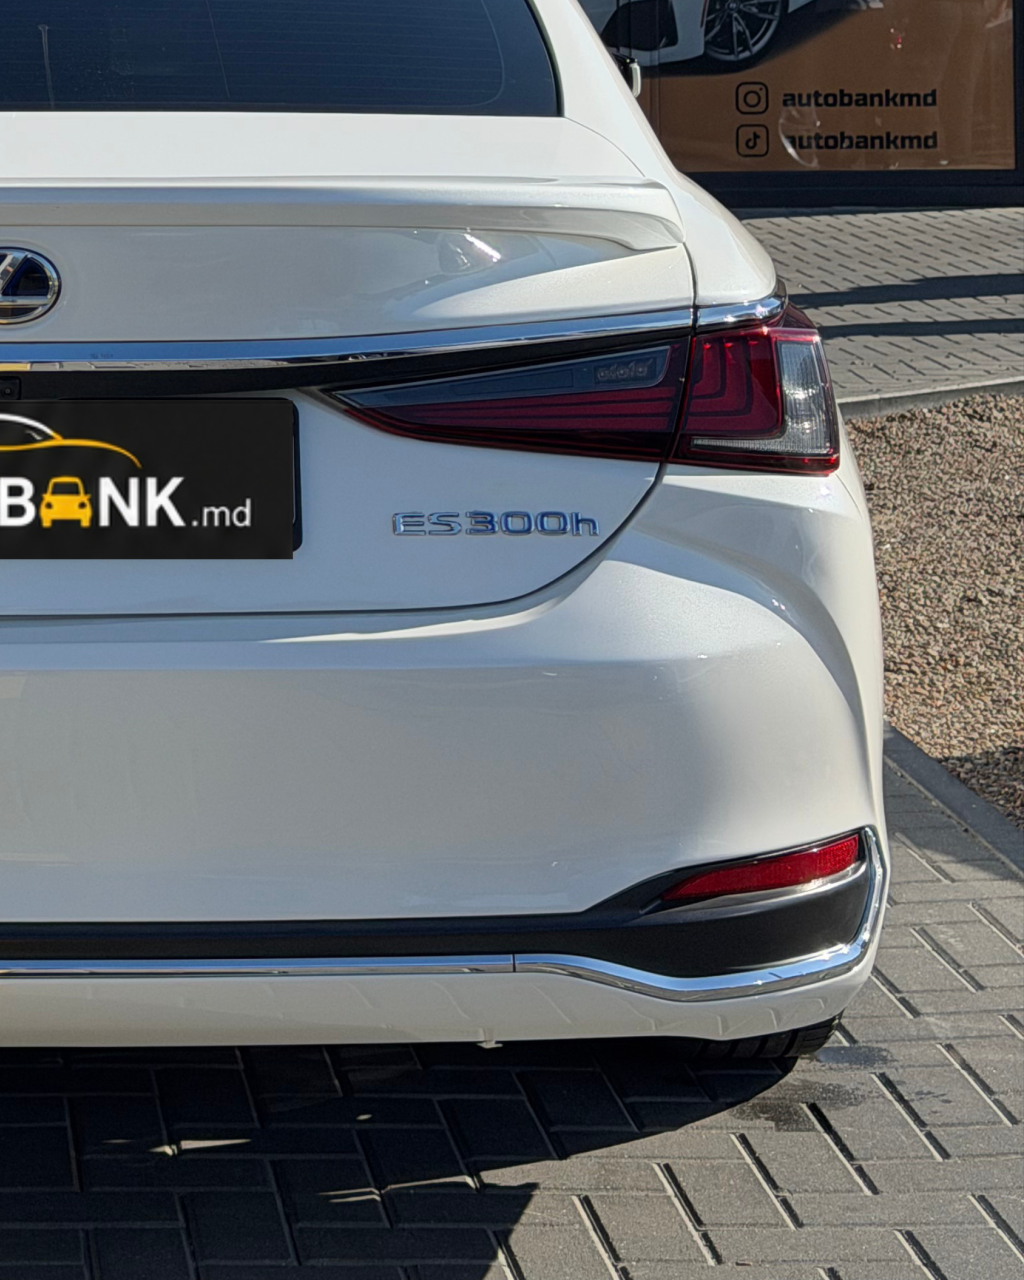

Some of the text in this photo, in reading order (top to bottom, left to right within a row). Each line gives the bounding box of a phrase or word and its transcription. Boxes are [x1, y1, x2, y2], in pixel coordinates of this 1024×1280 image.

[782, 89, 937, 108] autobankmd
[783, 130, 938, 151] autobankmd
[392, 510, 600, 537] ES300h
